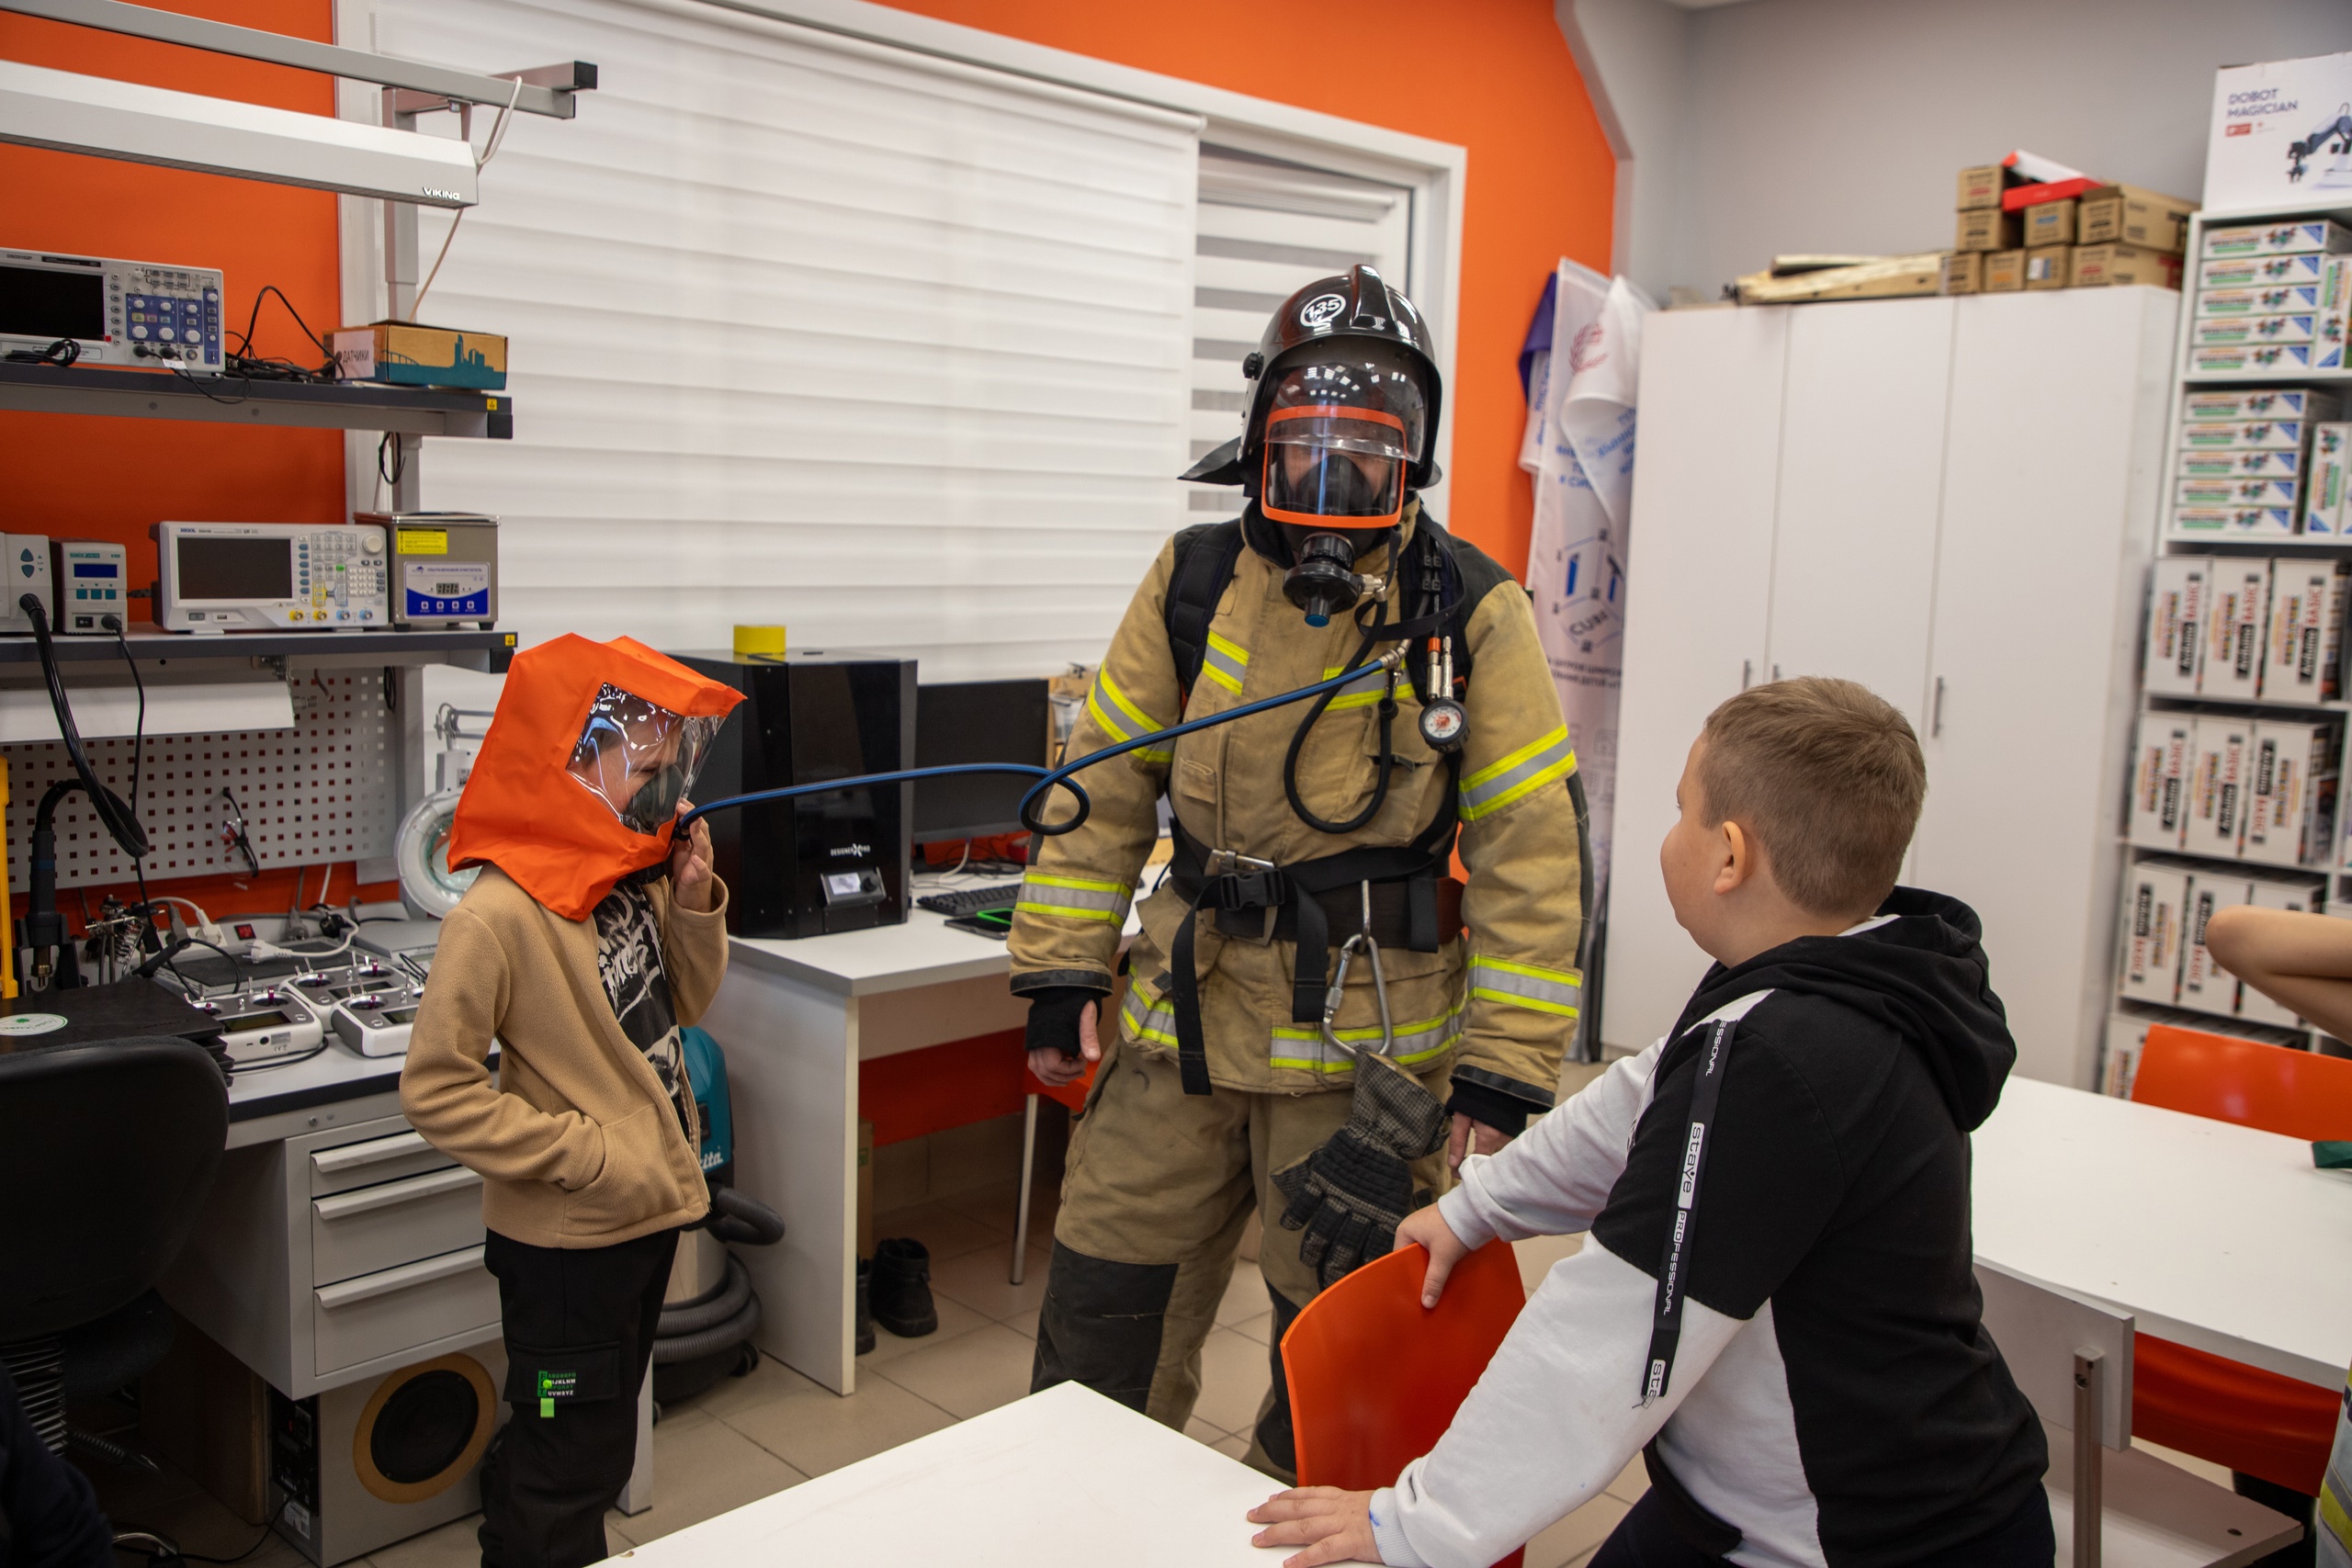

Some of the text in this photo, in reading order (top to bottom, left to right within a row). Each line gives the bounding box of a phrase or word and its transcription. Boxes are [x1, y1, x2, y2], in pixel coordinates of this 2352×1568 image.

[2228, 88, 2278, 105] DOBOT
[2227, 100, 2299, 118] MAGICIAN
[423, 186, 460, 201] VIKING
[343, 349, 369, 365] ДАТЧИКИ
